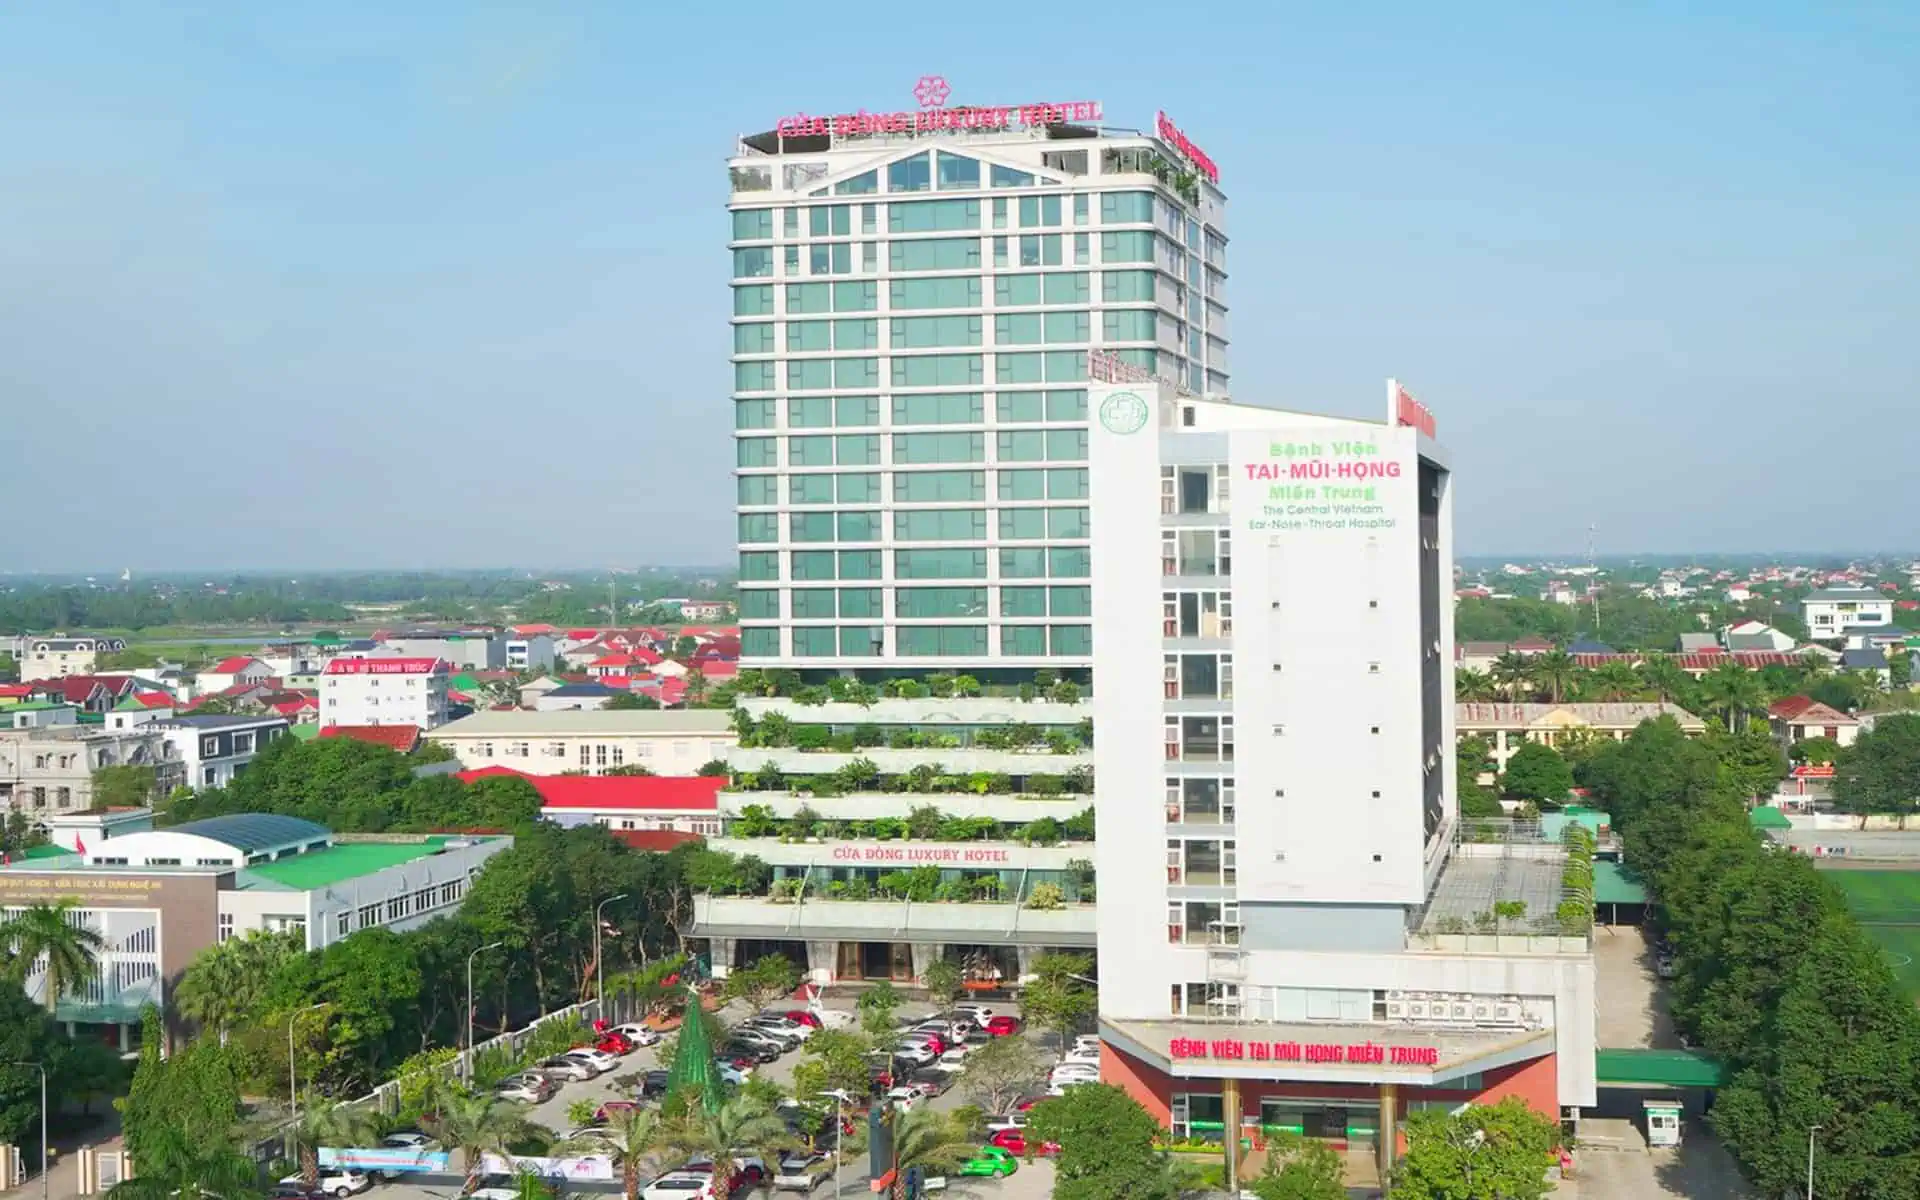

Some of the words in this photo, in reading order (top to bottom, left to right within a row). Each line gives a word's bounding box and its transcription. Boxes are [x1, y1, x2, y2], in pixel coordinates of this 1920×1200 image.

[1019, 102, 1103, 125] HOTEL
[1322, 486, 1376, 501] Trung
[1333, 504, 1383, 513] Vietnam
[1350, 517, 1395, 528] Hospital
[907, 848, 960, 861] LUXURY
[964, 850, 1009, 861] HOTEL
[1248, 1042, 1271, 1060] TAI
[1389, 1047, 1438, 1065] TRUNG
